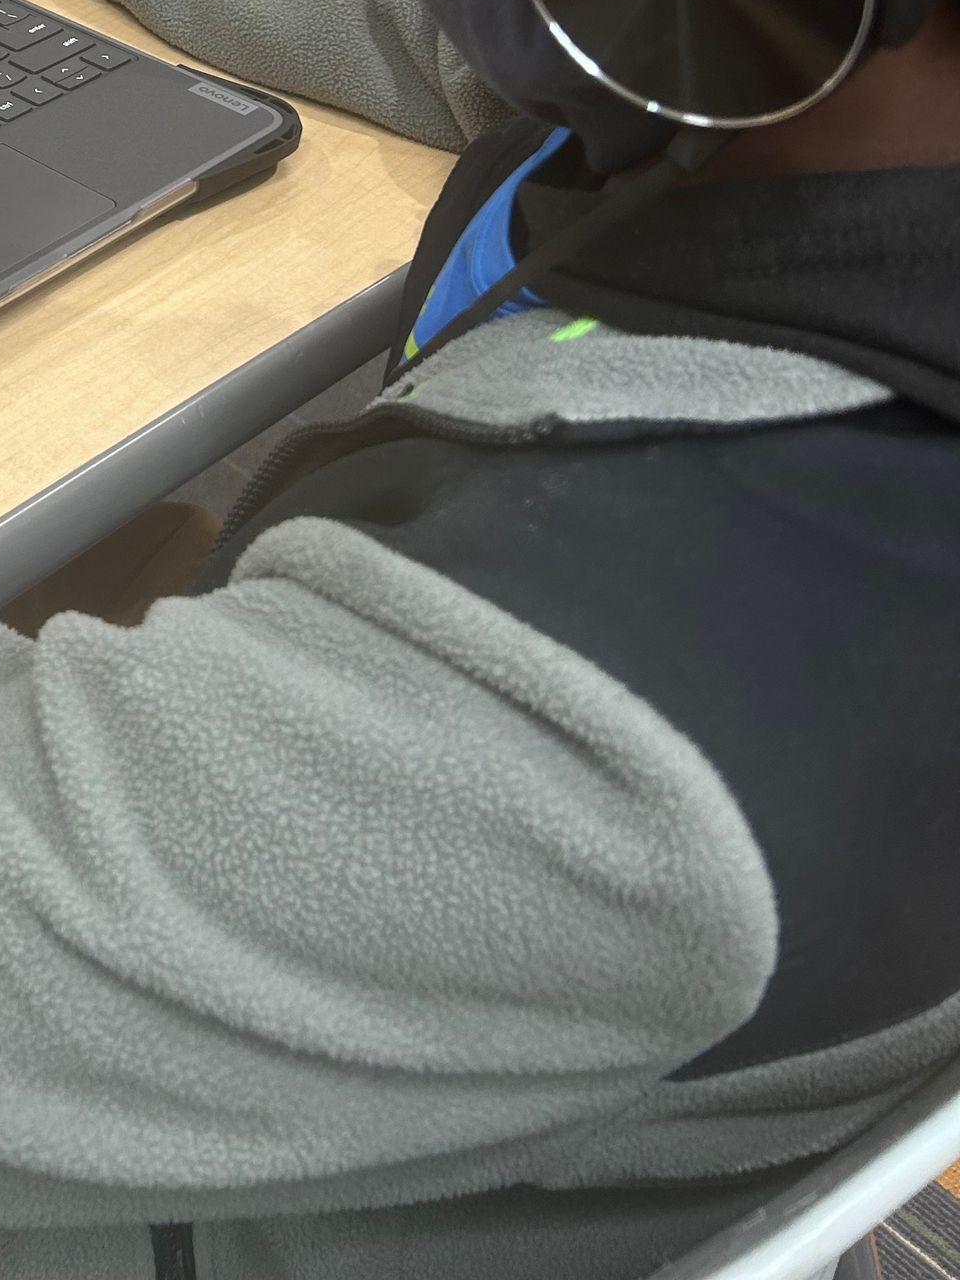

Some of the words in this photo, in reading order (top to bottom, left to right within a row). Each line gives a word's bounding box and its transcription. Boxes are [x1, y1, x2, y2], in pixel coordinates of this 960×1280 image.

[28, 23, 46, 34] enter
[199, 86, 249, 111] Lenovo
[0, 101, 14, 111] ctrl
